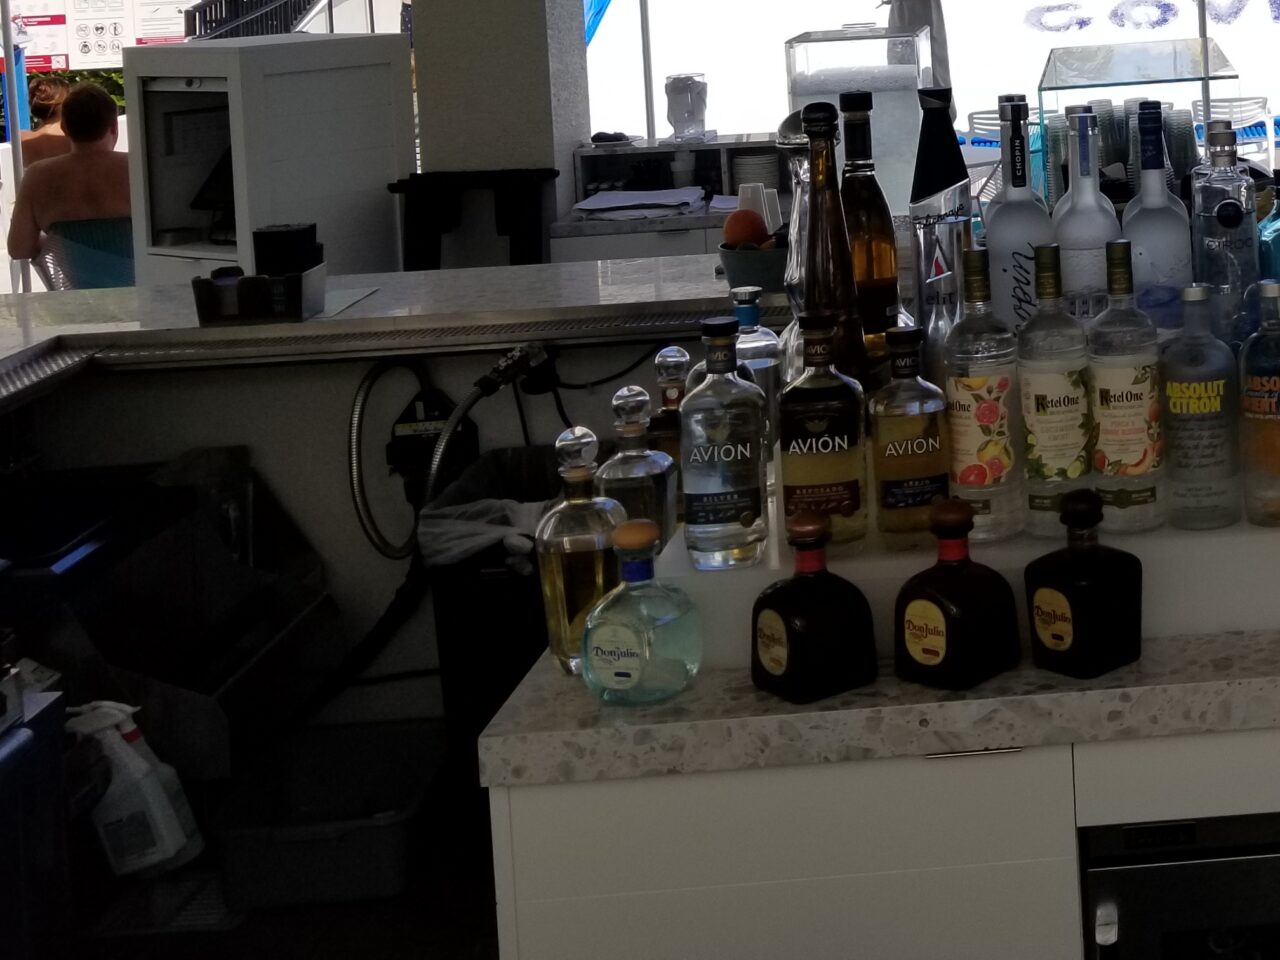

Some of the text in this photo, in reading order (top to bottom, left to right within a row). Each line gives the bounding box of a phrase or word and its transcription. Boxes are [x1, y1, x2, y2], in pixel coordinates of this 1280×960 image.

[1014, 139, 1022, 176] CHOPIN
[1100, 388, 1144, 407] Ketel One
[1166, 379, 1226, 398] ABSOLUT
[1034, 394, 1080, 413] Ketel One
[1169, 395, 1222, 414] CITRON
[689, 442, 751, 463] AVIÓN
[788, 433, 848, 455] AVIÓN
